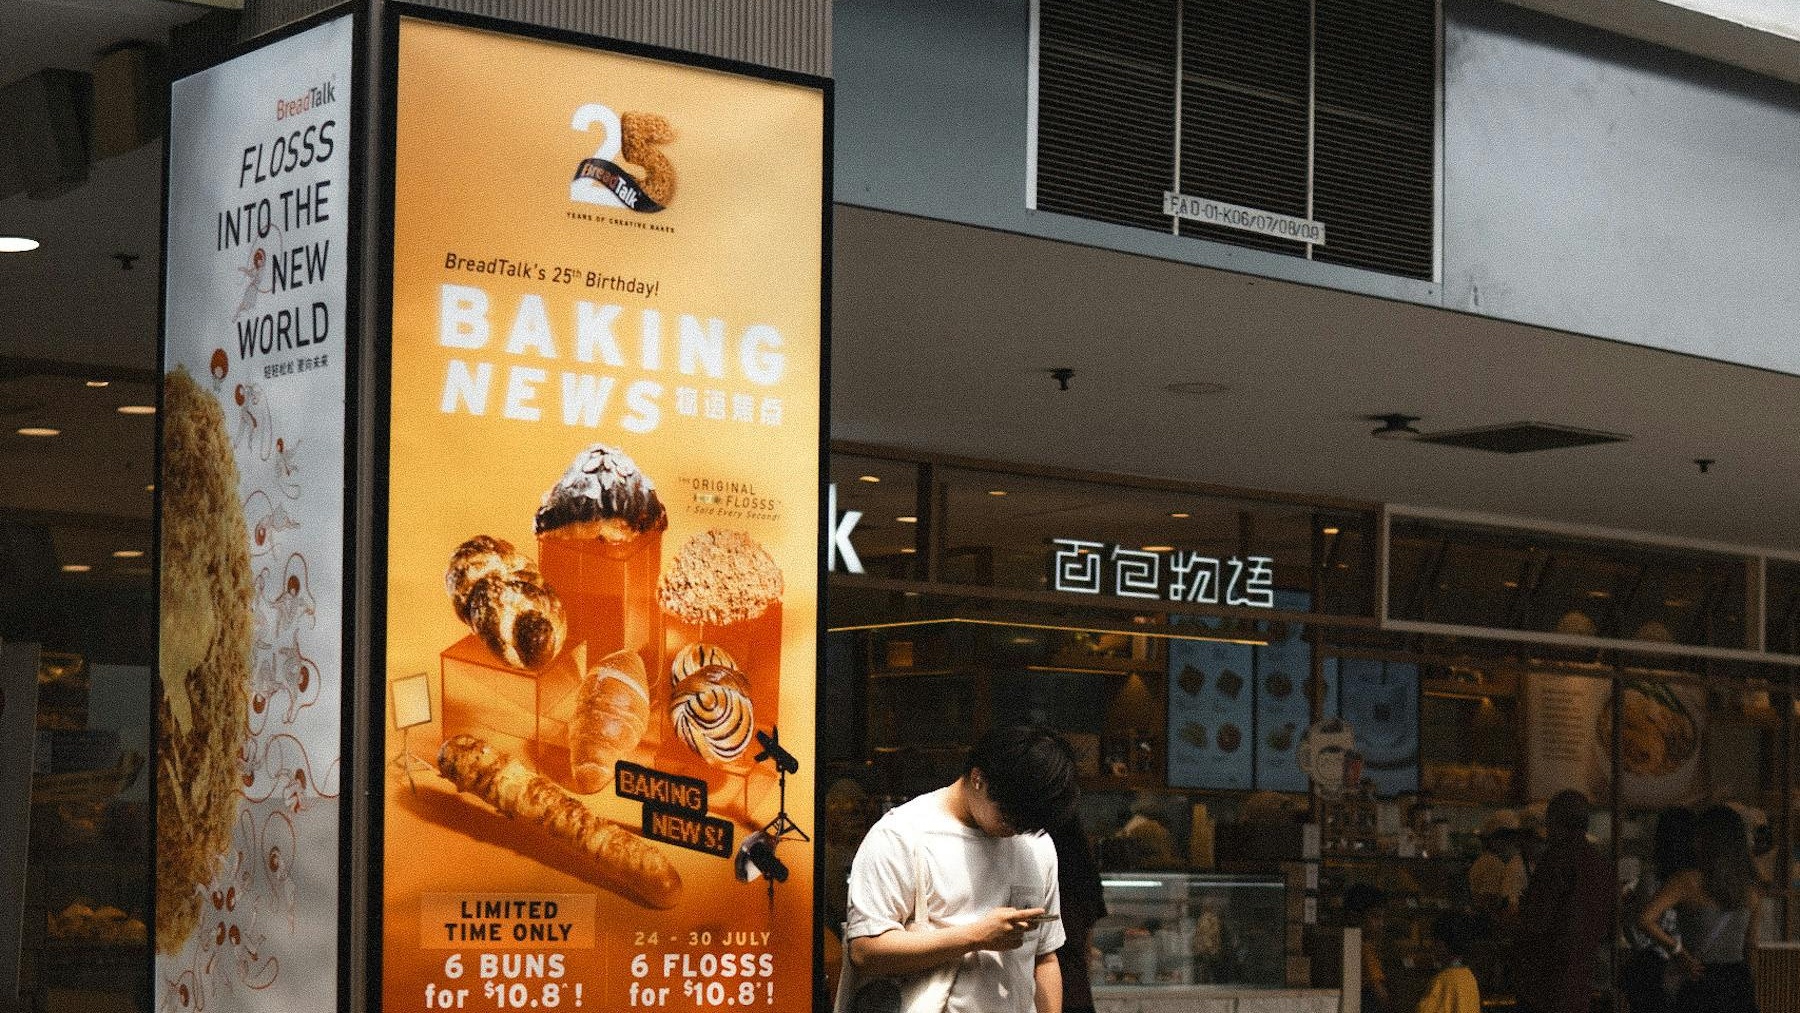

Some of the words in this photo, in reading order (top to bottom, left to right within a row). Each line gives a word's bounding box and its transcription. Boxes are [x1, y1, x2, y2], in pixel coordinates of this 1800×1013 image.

[276, 81, 336, 121] BreadTalk
[239, 120, 336, 188] FLOSSS
[217, 198, 271, 251] INTO
[280, 180, 331, 232] THE
[566, 211, 592, 221] YEARS
[609, 218, 646, 229] CREATIVE
[271, 240, 331, 294] NEW
[445, 253, 546, 281] BreadTalk's
[552, 267, 582, 284] 25th
[586, 271, 659, 298] Birthday!
[236, 301, 330, 360] WORLD
[438, 283, 787, 386] BAKING
[440, 359, 664, 434] NEWS
[692, 478, 756, 496] ORIGINAL
[717, 508, 743, 519] Every
[620, 769, 702, 811] BAKING
[652, 810, 724, 851] NEWS!
[461, 900, 559, 919] LIMITED
[444, 923, 502, 941] TIME
[513, 923, 573, 941] ONLY
[634, 931, 658, 946] 24
[688, 931, 712, 946] 30
[722, 931, 771, 946] JULY
[444, 953, 464, 979] 6
[479, 953, 566, 979] BUNS
[630, 953, 649, 978] 6
[663, 953, 774, 978] FLOSSS
[424, 982, 470, 1009] for
[629, 981, 670, 1007] for
